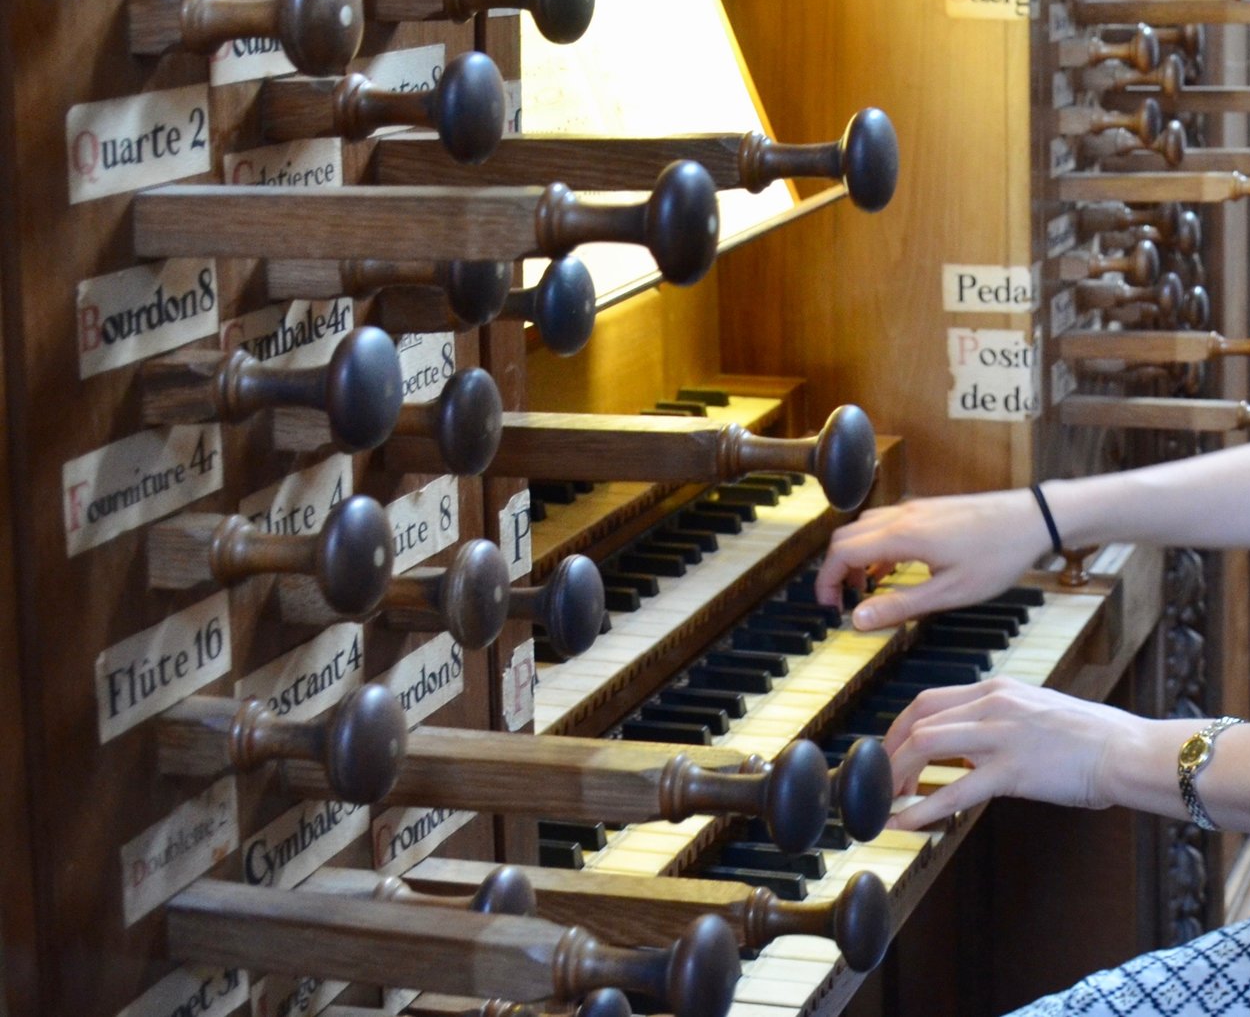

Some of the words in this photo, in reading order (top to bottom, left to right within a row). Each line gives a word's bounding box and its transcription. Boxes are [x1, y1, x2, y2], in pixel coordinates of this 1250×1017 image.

[72, 122, 180, 183] Quarte
[188, 107, 205, 150] 2
[961, 383, 997, 411] de
